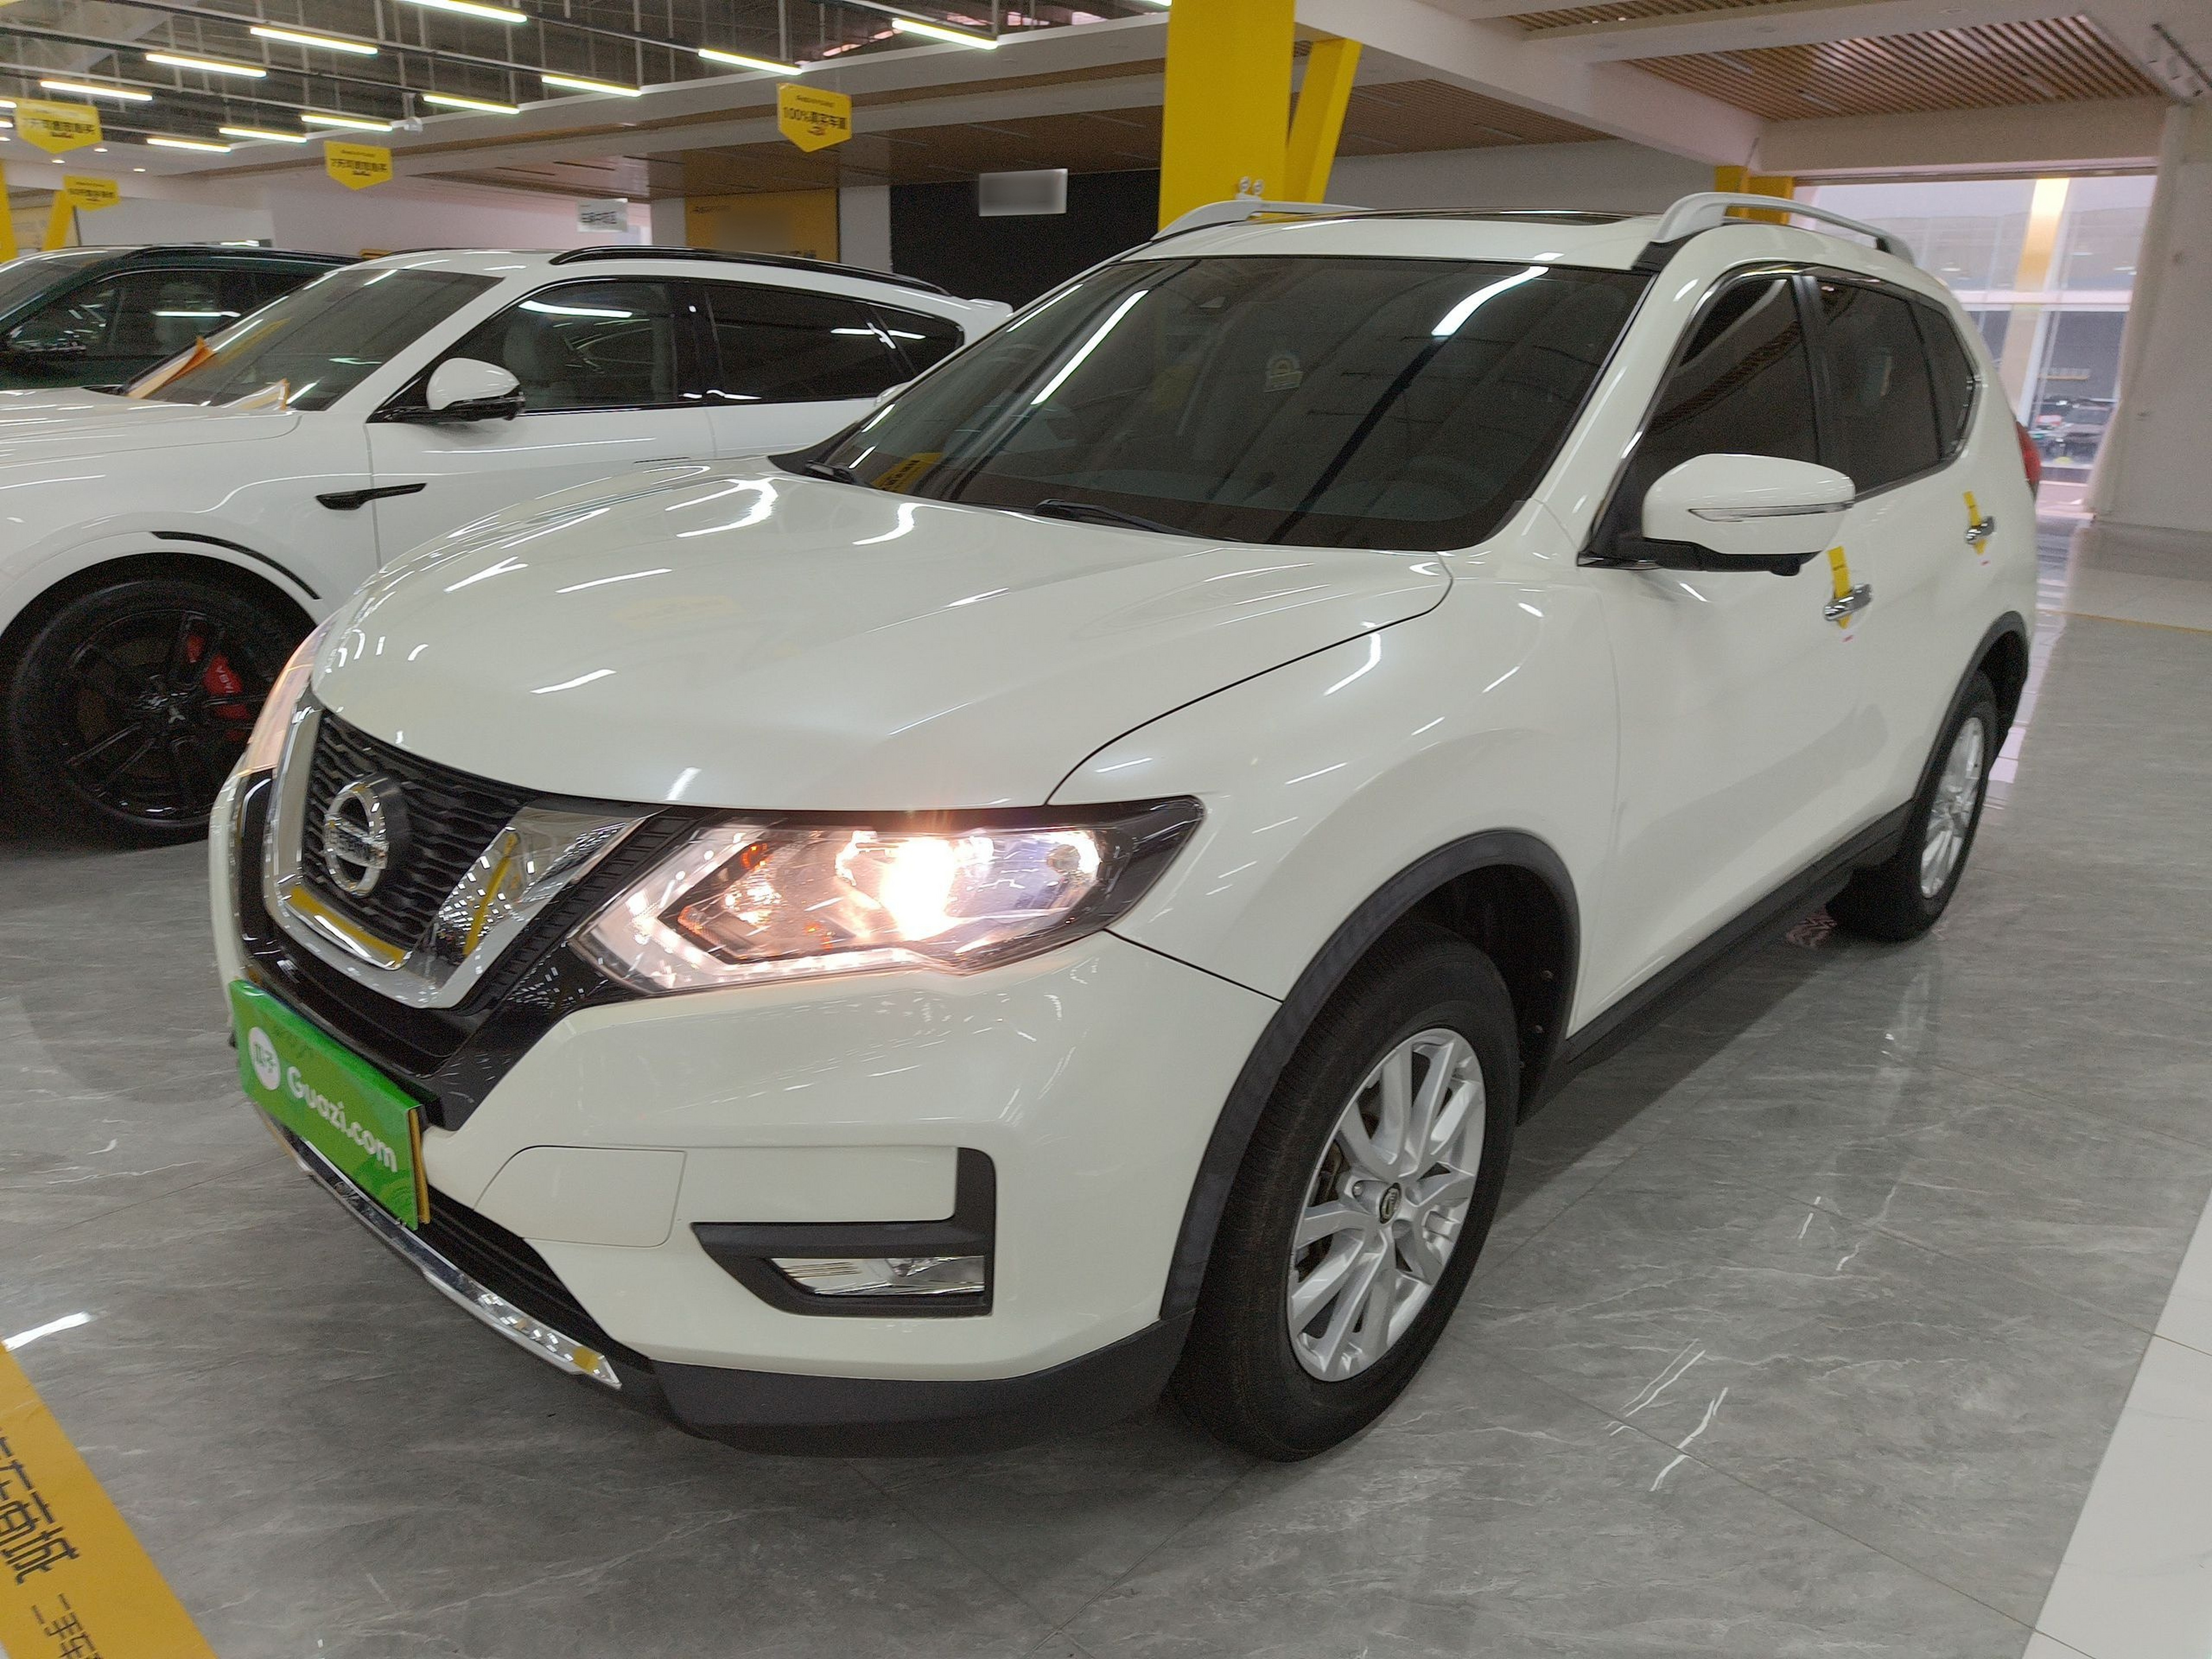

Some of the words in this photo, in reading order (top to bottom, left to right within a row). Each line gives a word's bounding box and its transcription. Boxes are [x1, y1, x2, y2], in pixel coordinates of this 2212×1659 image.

[287, 1066, 399, 1173] Guazi.com
[31, 1592, 105, 1659] 二手车
